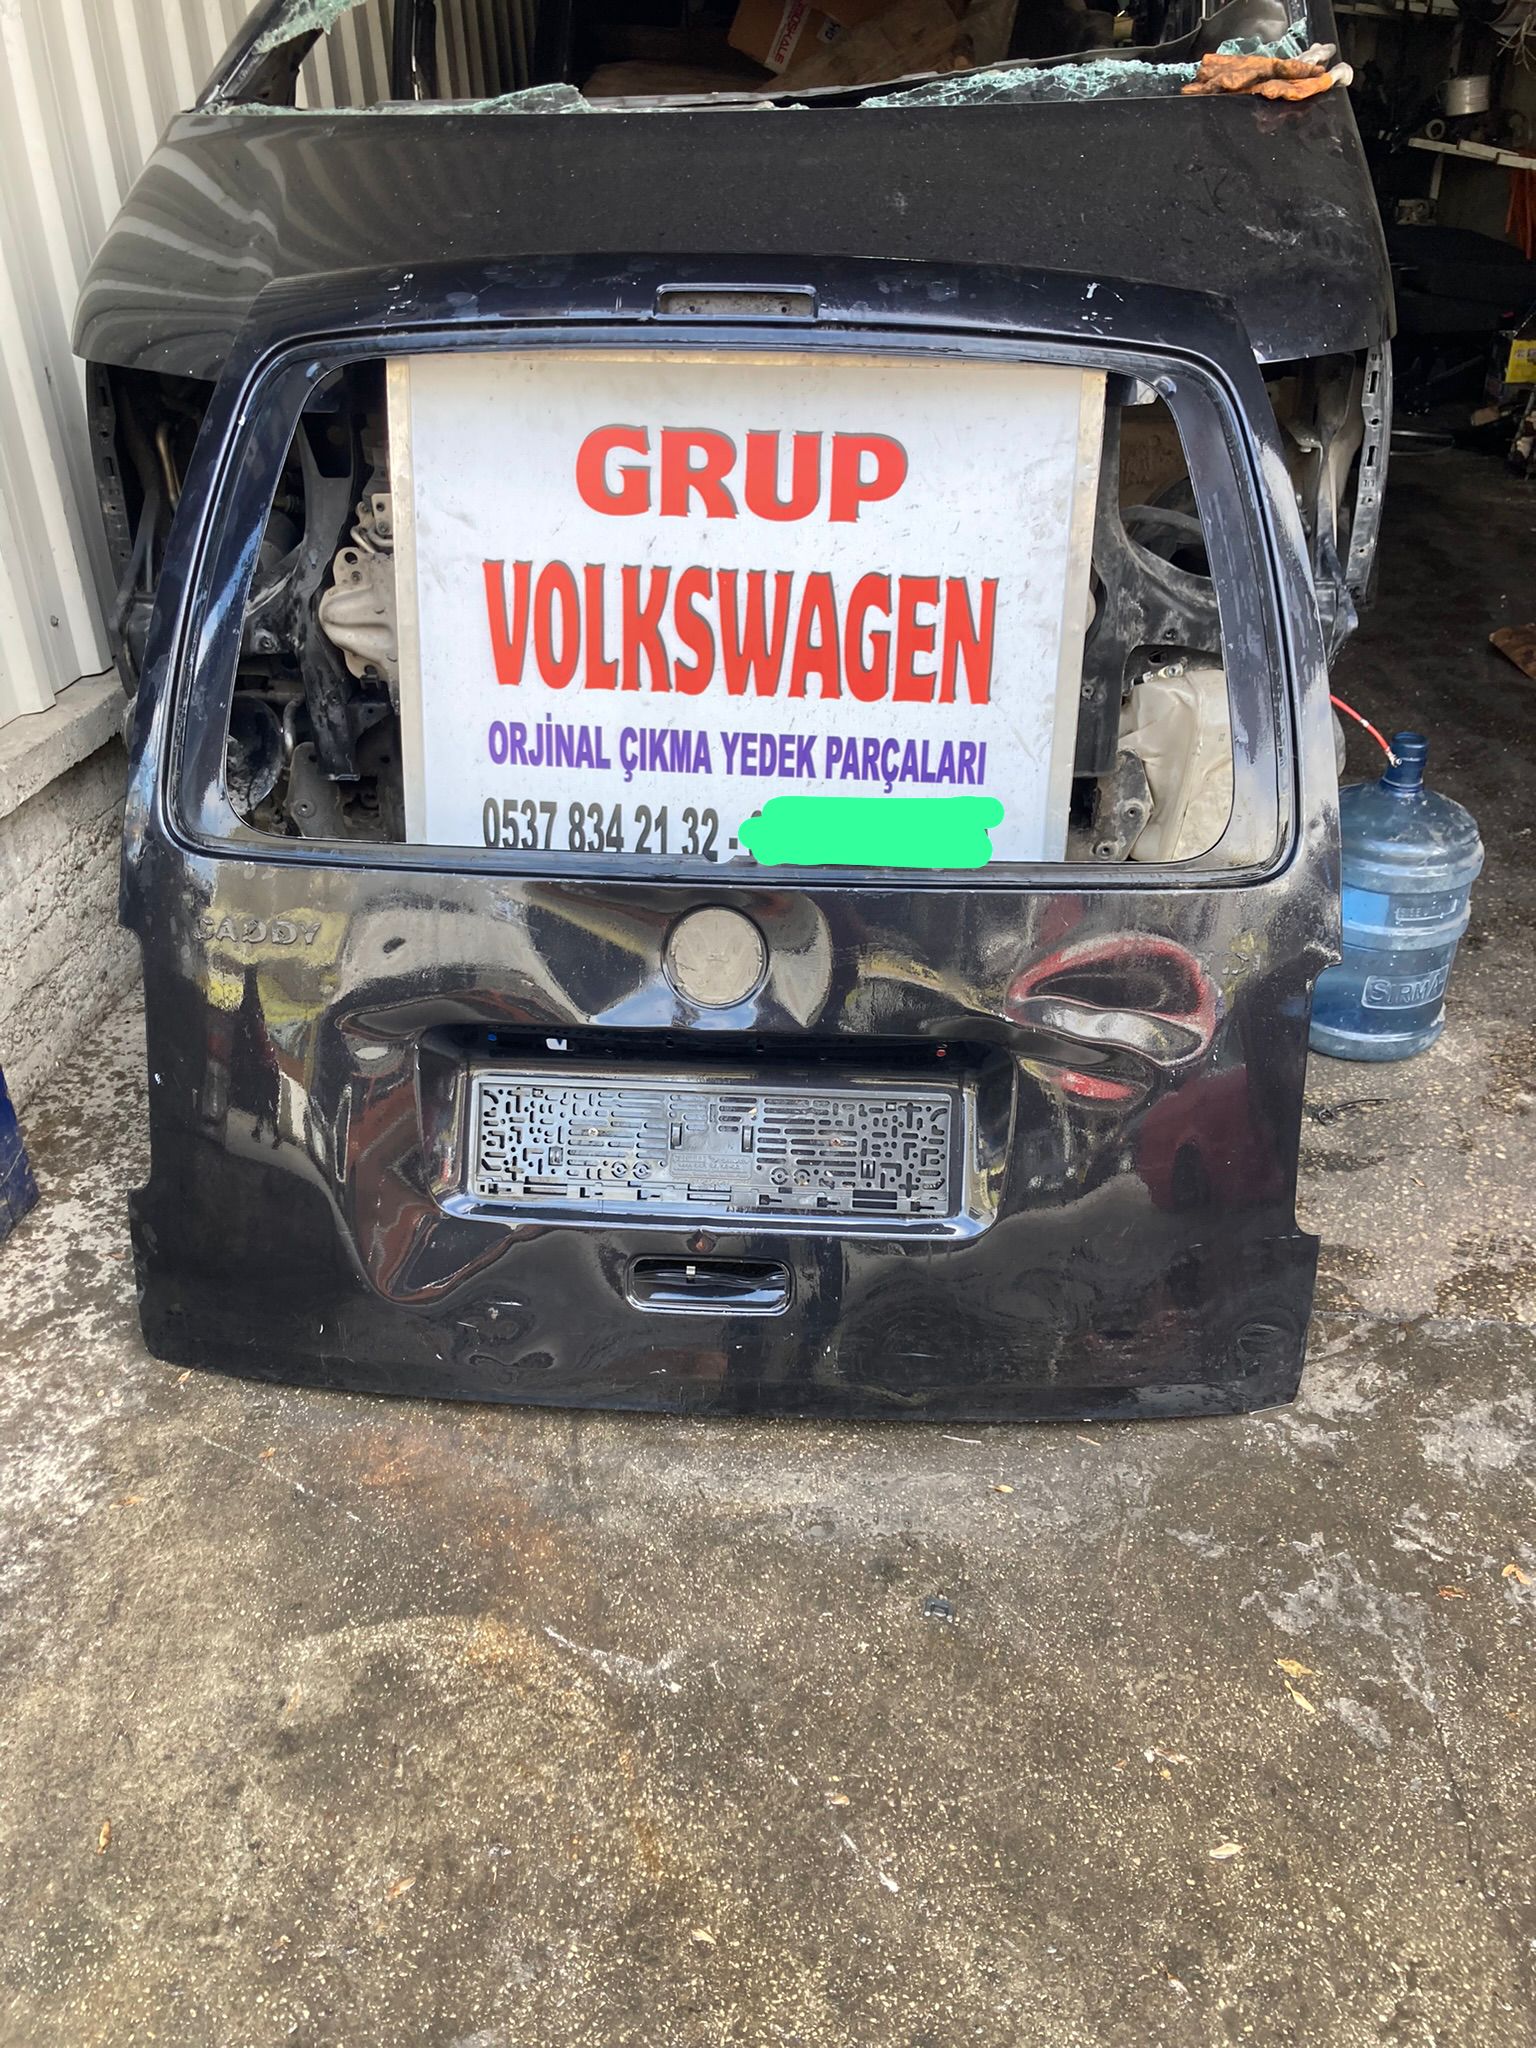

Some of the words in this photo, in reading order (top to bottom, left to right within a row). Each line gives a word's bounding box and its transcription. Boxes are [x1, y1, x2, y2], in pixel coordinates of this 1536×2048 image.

[576, 424, 908, 522] GRUP
[482, 559, 999, 704] VOLKSWAGEN
[488, 713, 611, 769] ORJİNAL
[619, 727, 712, 782] ÇIKMA
[720, 732, 817, 778] YEDEK
[825, 736, 987, 793] PARÇALARI
[483, 797, 557, 848] 0537
[568, 802, 625, 852] 834
[635, 805, 668, 854] 21
[682, 807, 718, 862] 32
[193, 916, 321, 945] CADDY
